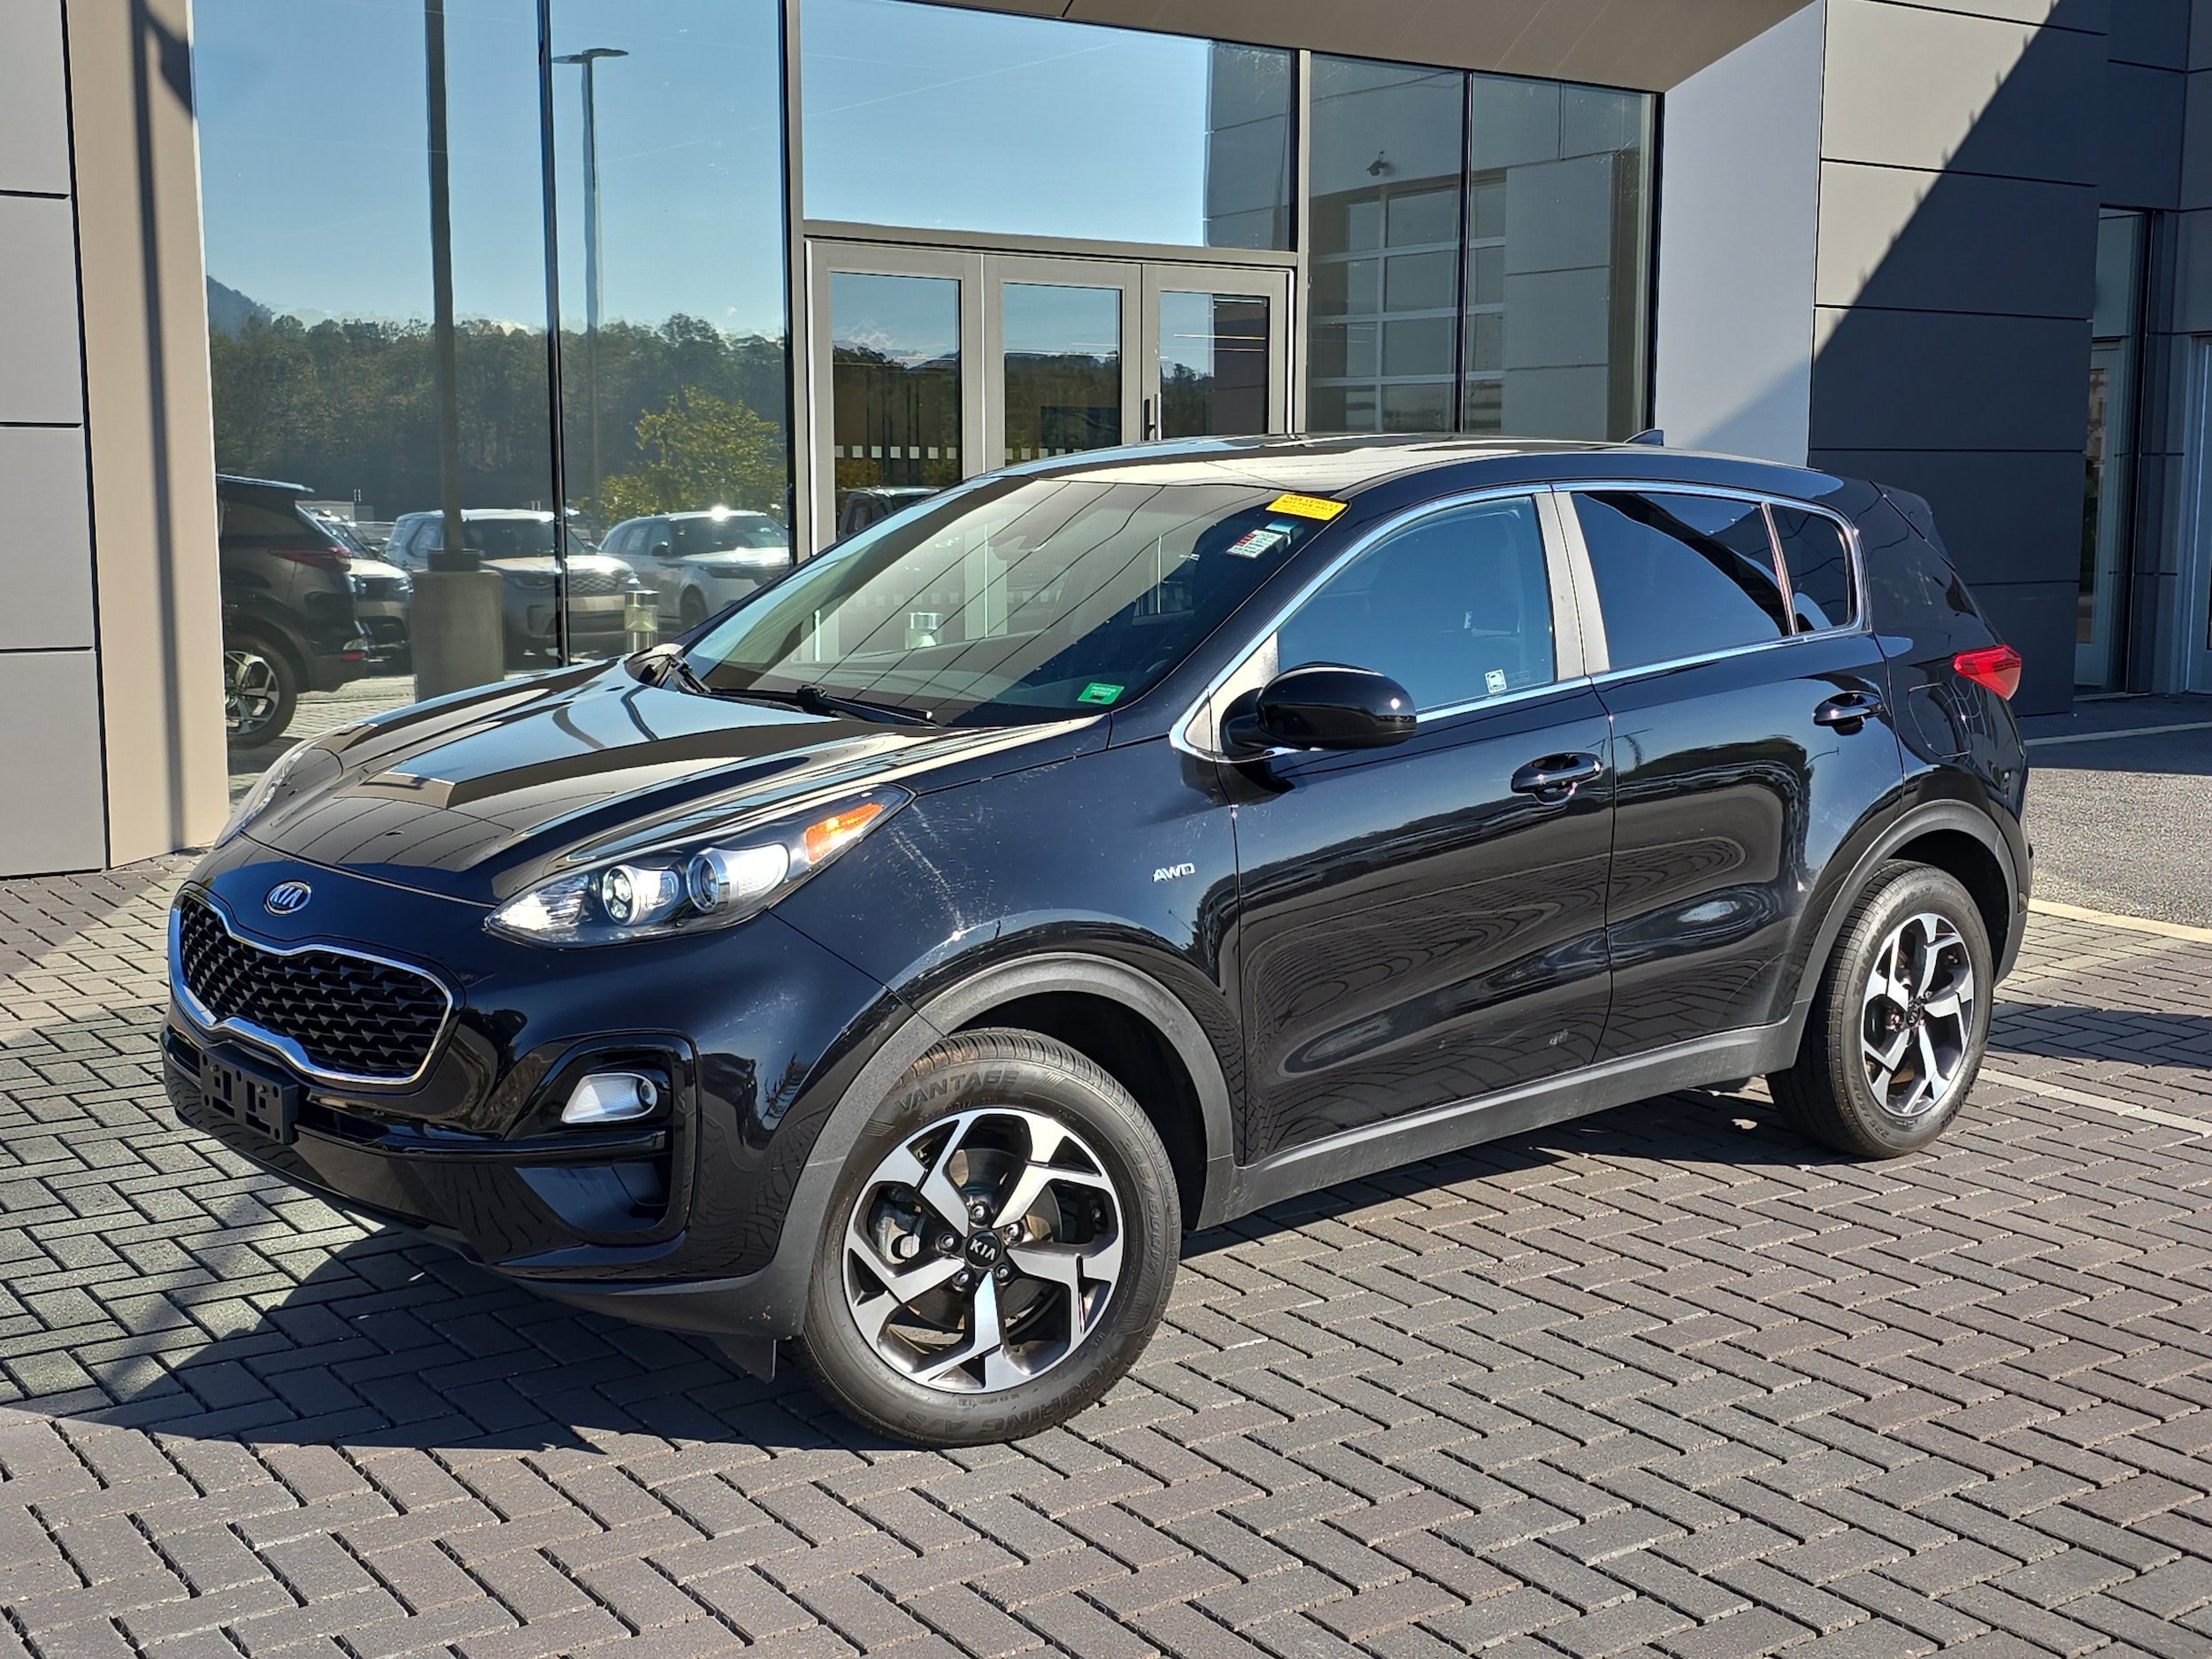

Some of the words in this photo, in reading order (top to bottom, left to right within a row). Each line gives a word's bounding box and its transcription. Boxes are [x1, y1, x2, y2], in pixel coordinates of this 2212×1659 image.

[1153, 863, 1195, 882] AWD
[269, 886, 303, 908] KIA
[895, 1071, 1018, 1111] VANTAGE
[969, 1238, 996, 1261] KIA
[979, 1354, 1118, 1434] TOURING
[902, 1410, 969, 1434] A/S
